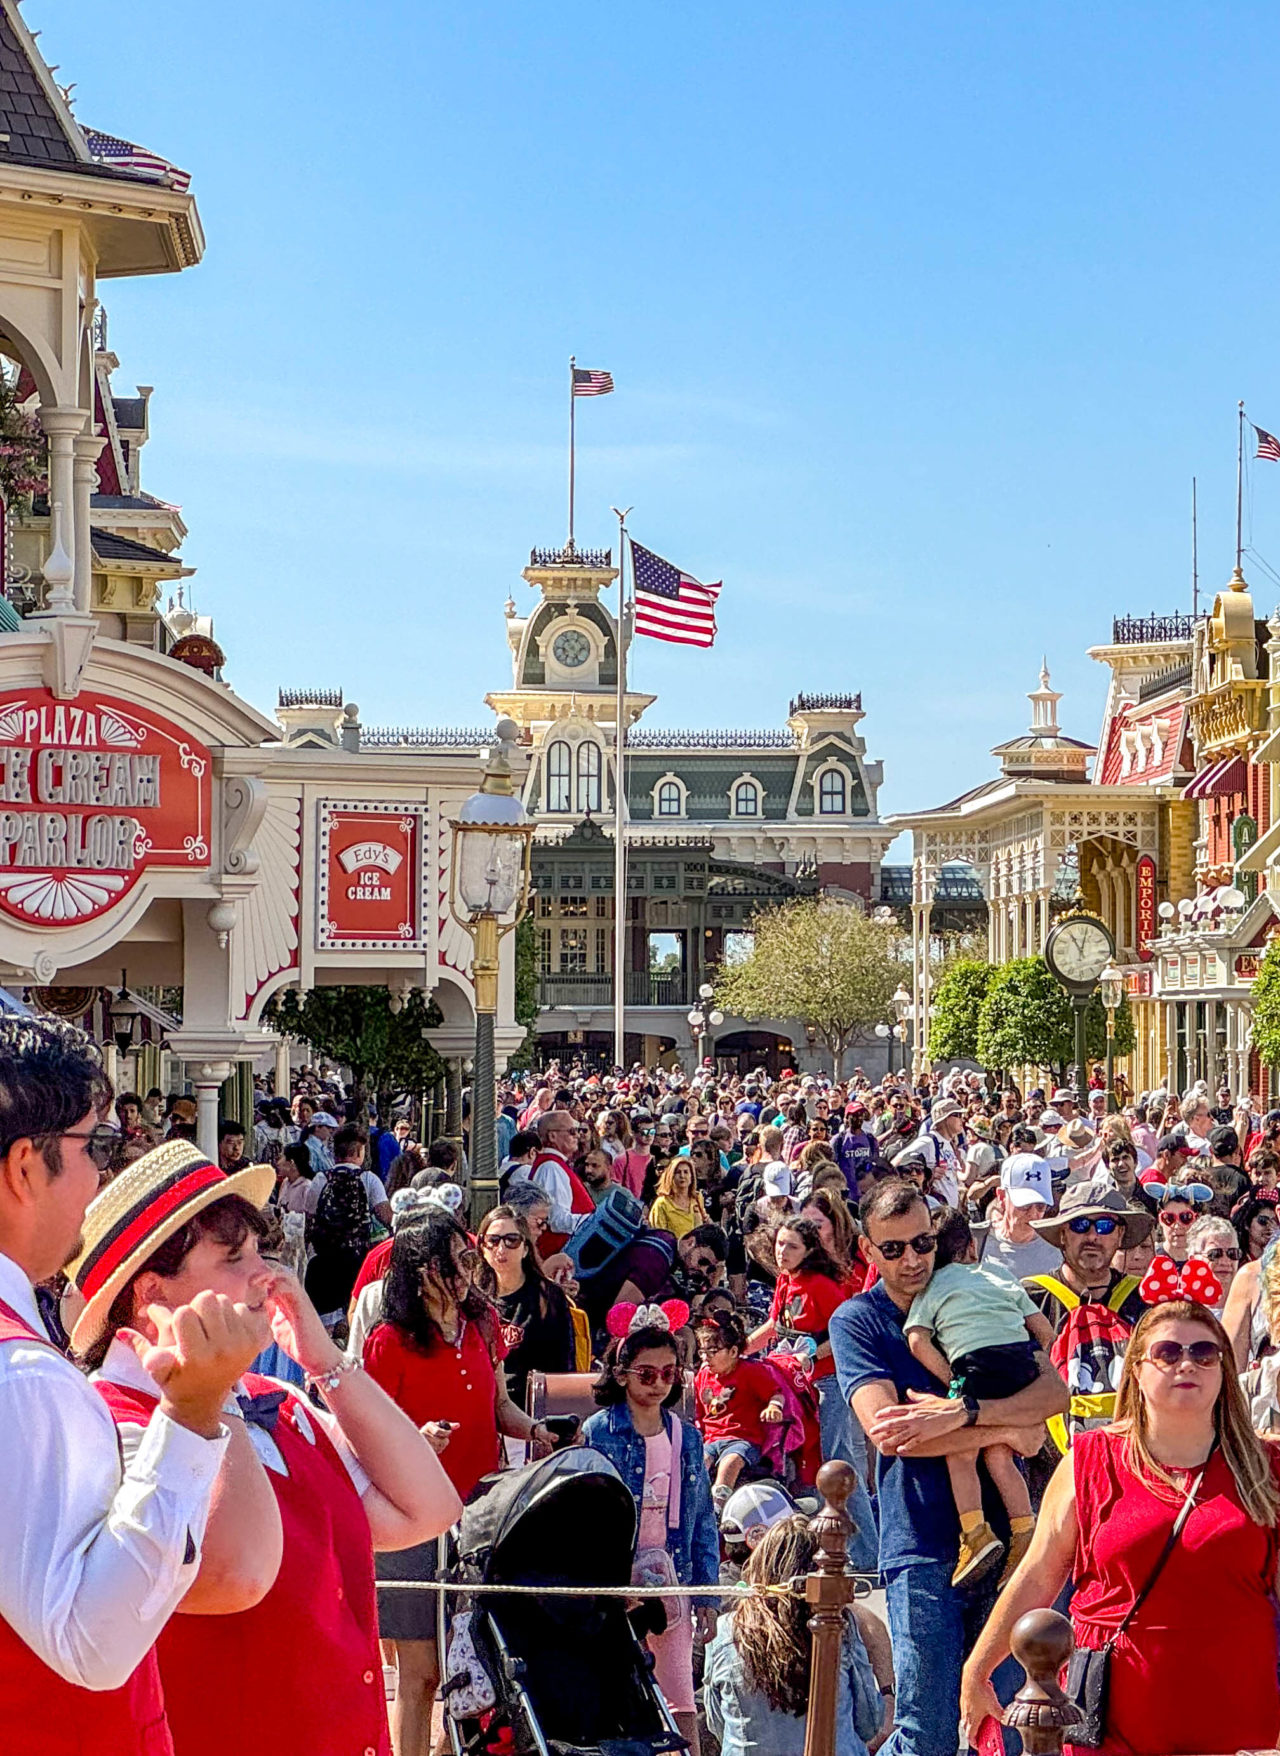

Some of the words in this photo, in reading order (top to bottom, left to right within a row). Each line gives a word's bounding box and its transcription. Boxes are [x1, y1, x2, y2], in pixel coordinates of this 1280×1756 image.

[24, 705, 98, 746] PLAZA
[37, 749, 161, 808] CREAM
[0, 810, 135, 870] PARLOR
[353, 844, 390, 864] Edy's
[347, 887, 392, 900] CREAM
[360, 872, 380, 885] ICE
[1139, 866, 1153, 951] EMPORIUM
[845, 1148, 870, 1158] STORM
